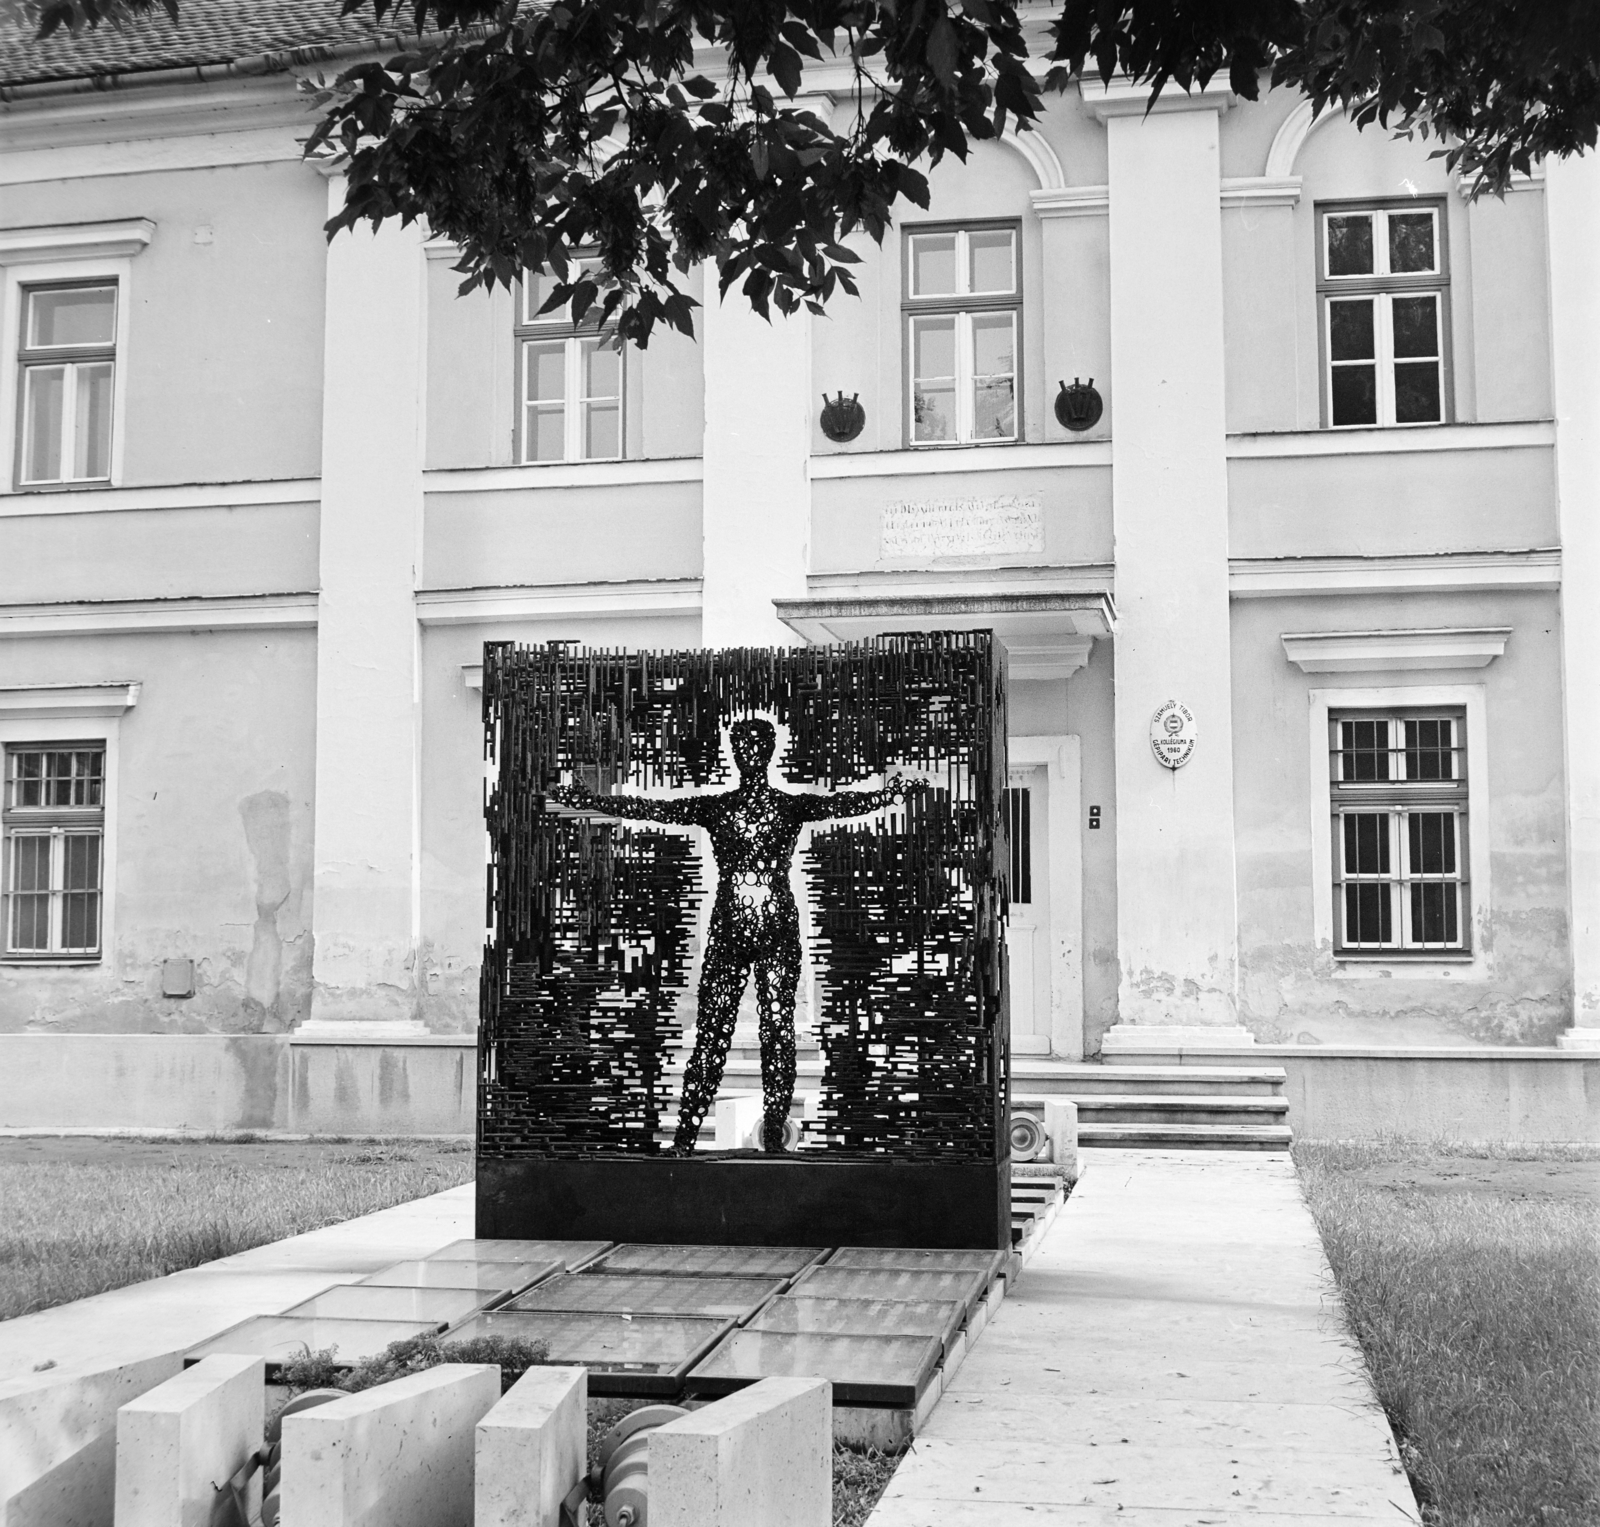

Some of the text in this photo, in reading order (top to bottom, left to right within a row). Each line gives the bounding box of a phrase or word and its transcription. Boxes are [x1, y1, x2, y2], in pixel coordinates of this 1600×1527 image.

[1154, 703, 1193, 723] SZAMUELY TIBOR
[1153, 739, 1195, 764] GÉPIPARI TECHNIKUM
